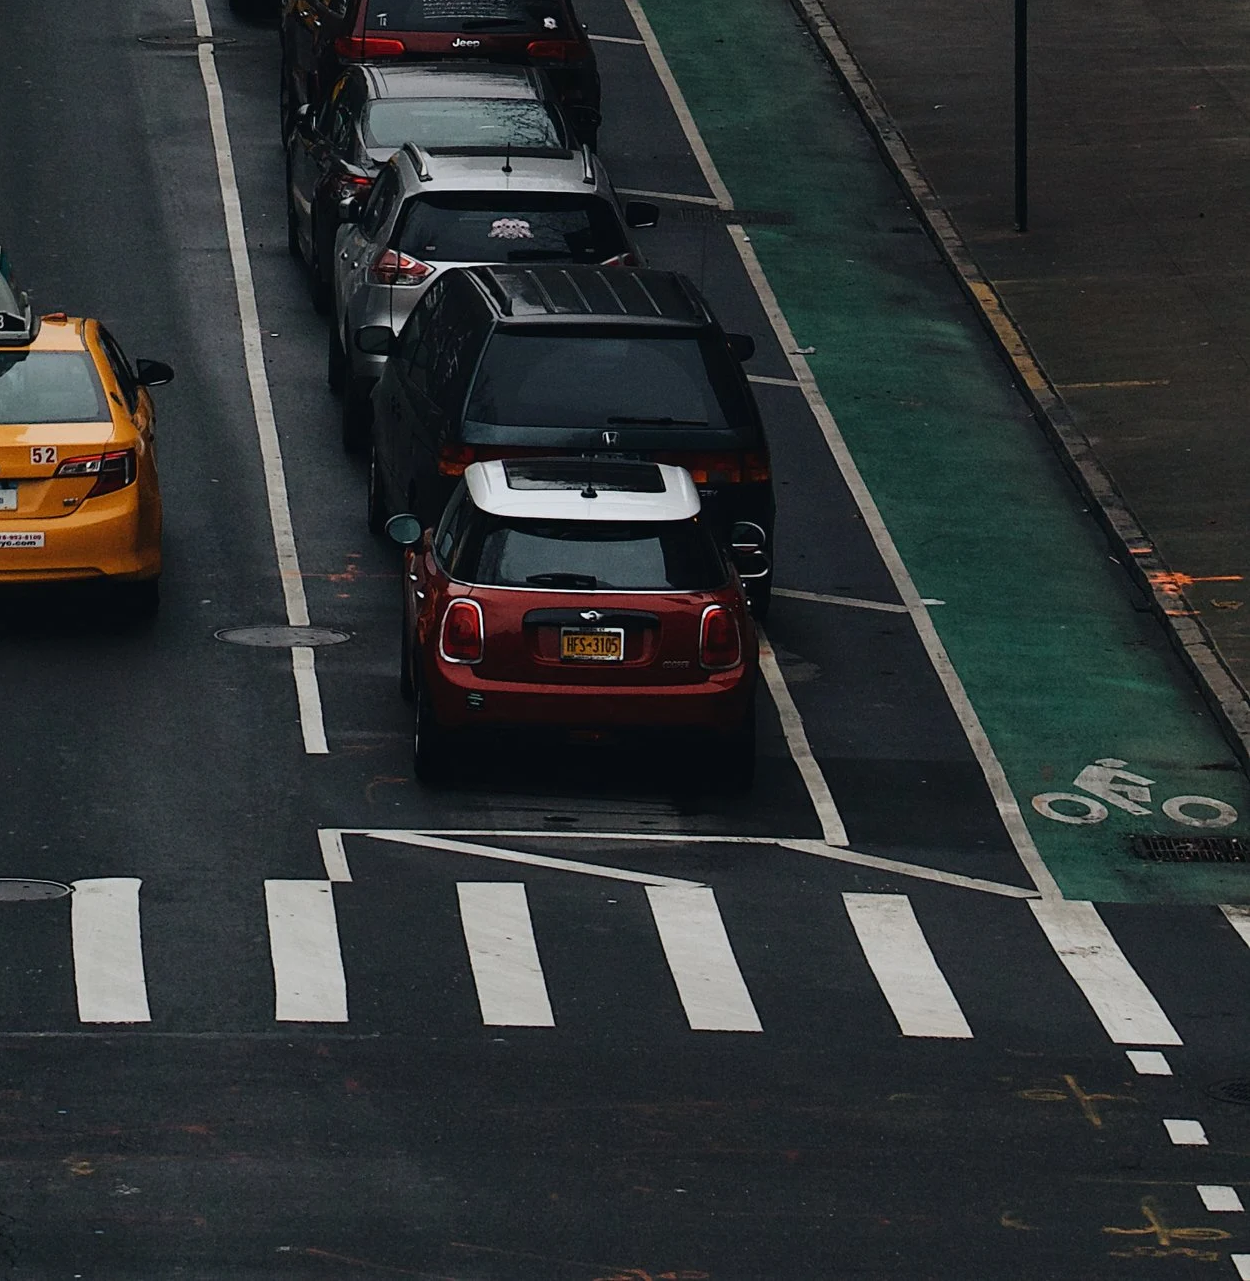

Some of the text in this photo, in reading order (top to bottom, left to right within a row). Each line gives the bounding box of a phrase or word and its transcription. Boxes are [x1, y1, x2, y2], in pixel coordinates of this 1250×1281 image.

[452, 38, 480, 49] Jeep
[33, 447, 55, 463] 52
[593, 637, 618, 653] 3105
